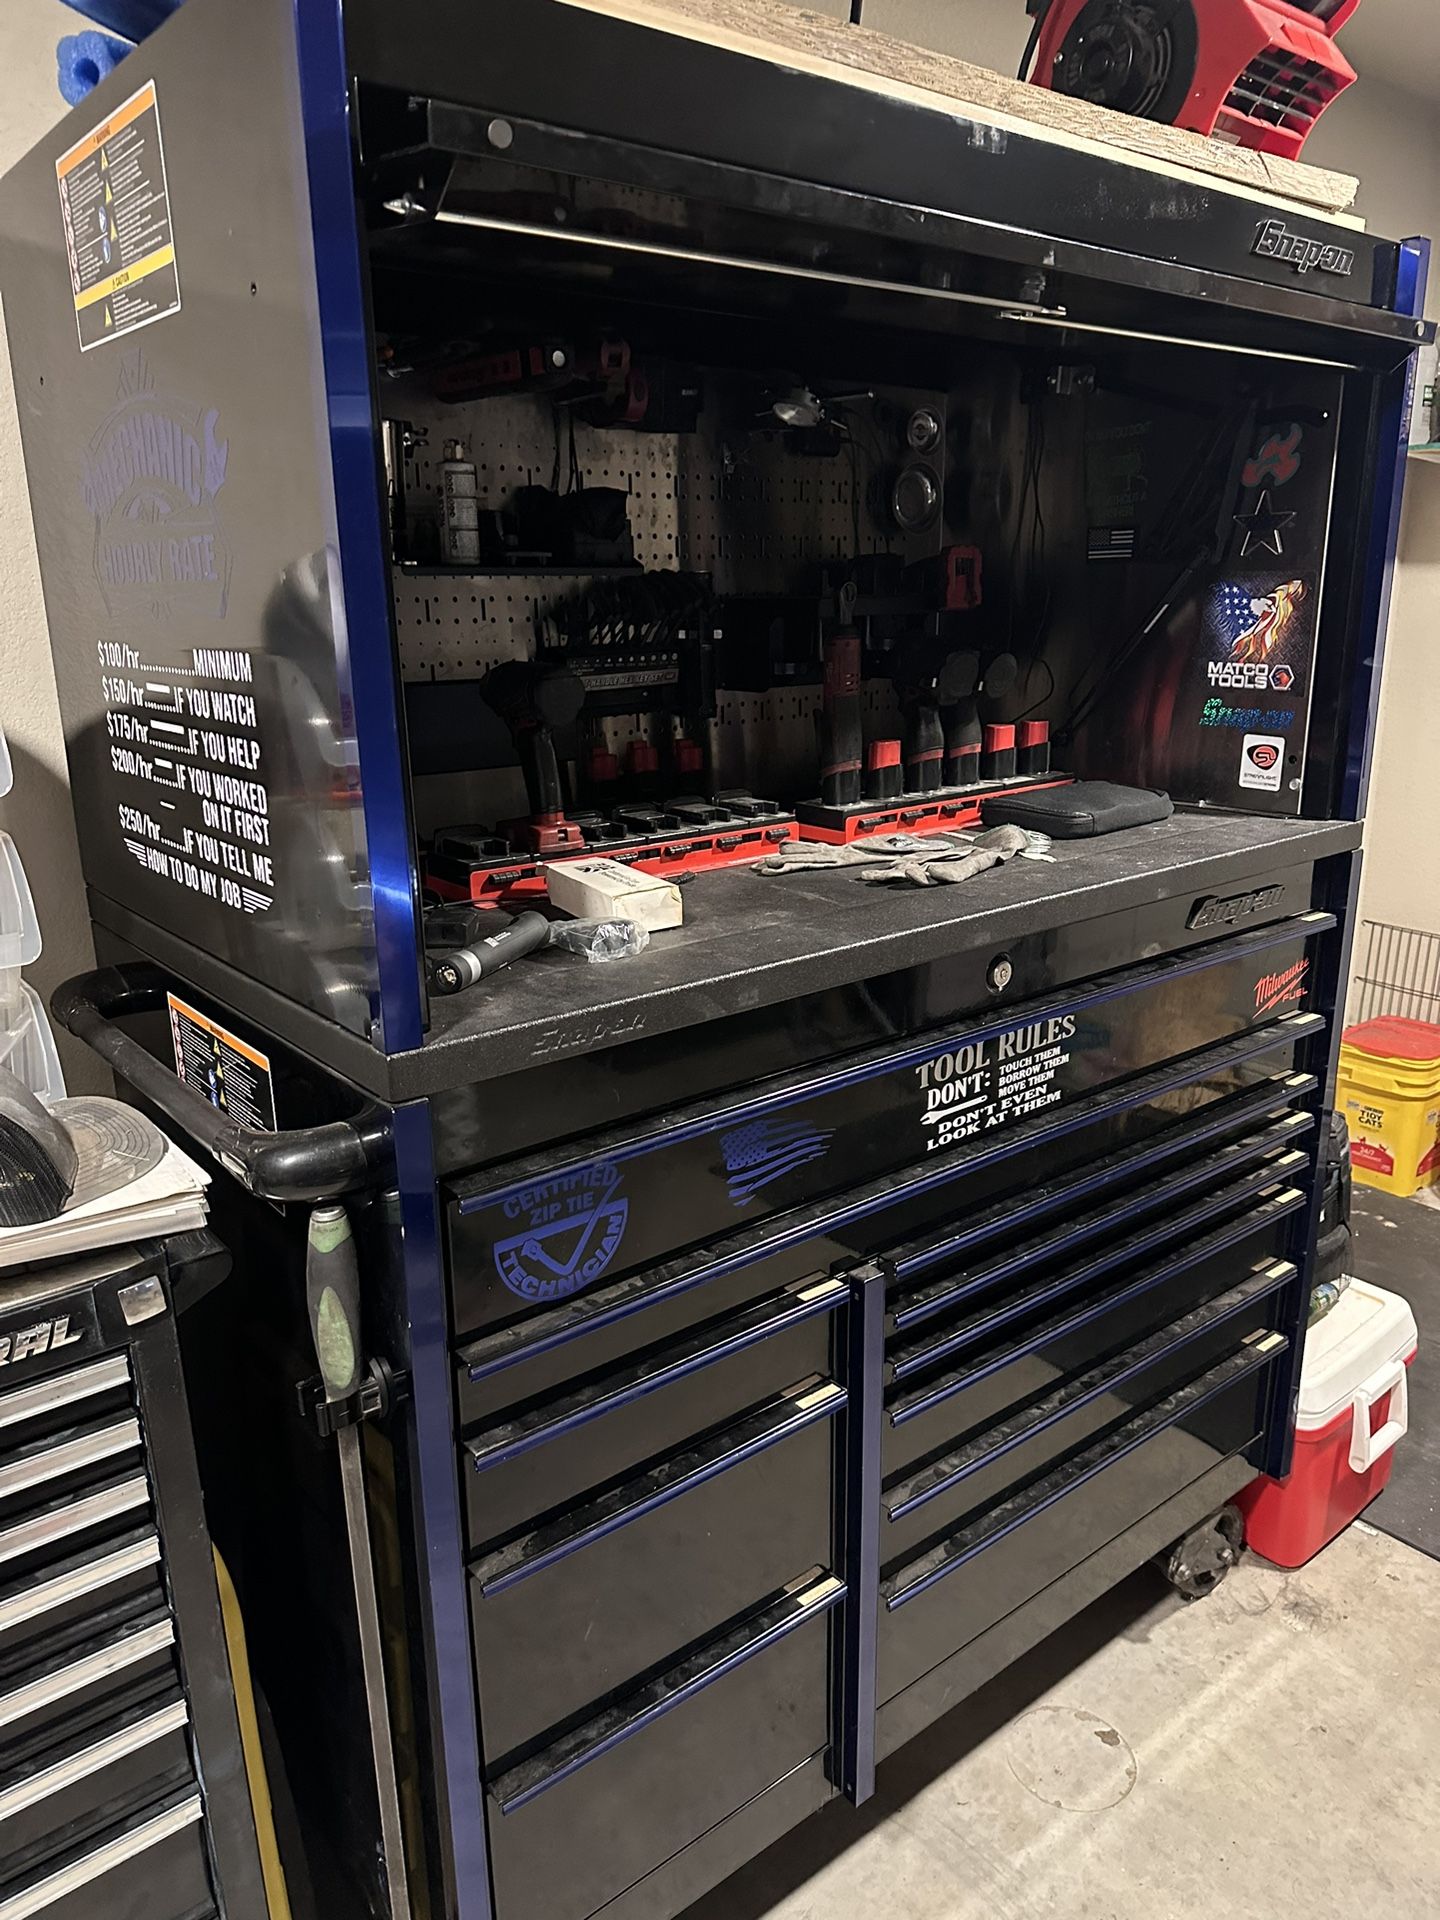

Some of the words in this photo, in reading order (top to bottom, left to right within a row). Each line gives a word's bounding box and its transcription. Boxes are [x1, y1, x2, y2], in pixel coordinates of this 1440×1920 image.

[116, 271, 130, 286] CAUTION
[103, 541, 164, 585] HOURLY
[169, 534, 219, 581] RATE
[1207, 661, 1269, 676] MATCO
[1207, 673, 1268, 690] TOOLS
[185, 688, 210, 719] YOU
[211, 690, 257, 728] WATCH
[201, 730, 226, 763] YOU
[227, 735, 260, 770] HELP
[188, 766, 212, 798] YOU
[212, 770, 268, 815] WORKED
[202, 799, 219, 830] ON
[220, 804, 232, 833] IT
[235, 810, 270, 846] FIRST
[146, 847, 169, 877] HOW
[169, 856, 183, 884] TO
[184, 861, 199, 891] DO
[199, 868, 217, 899] MY
[220, 877, 241, 909] JOB
[195, 832, 219, 865] YOU
[220, 841, 251, 877] TELL
[252, 852, 274, 887] ME
[1254, 957, 1310, 1008] Milwaukee
[1282, 987, 1309, 1003] FUEL
[915, 1041, 990, 1089] TOOL
[997, 1015, 1076, 1061] RULES
[998, 1064, 1042, 1087] BORROW
[1044, 1053, 1070, 1071] THEM
[999, 1056, 1032, 1076] TOUCH
[1034, 1046, 1061, 1063] THEM
[927, 1070, 991, 1110] DON'T:
[998, 1081, 1026, 1099] MOVE
[1028, 1069, 1055, 1087] THEM
[927, 1121, 981, 1151] LOOK
[984, 1111, 1009, 1128] AT
[1012, 1090, 1061, 1117] THEM
[938, 1103, 997, 1135] DON'T
[1001, 1084, 1048, 1111] EVEN
[1358, 1117, 1383, 1128] CATS
[1360, 1110, 1383, 1121] TIDY
[503, 1164, 617, 1219] CERTIFIED
[530, 1202, 561, 1226] ZIP
[567, 1191, 594, 1213] TIE
[502, 1214, 623, 1297] TECHNICIAN
